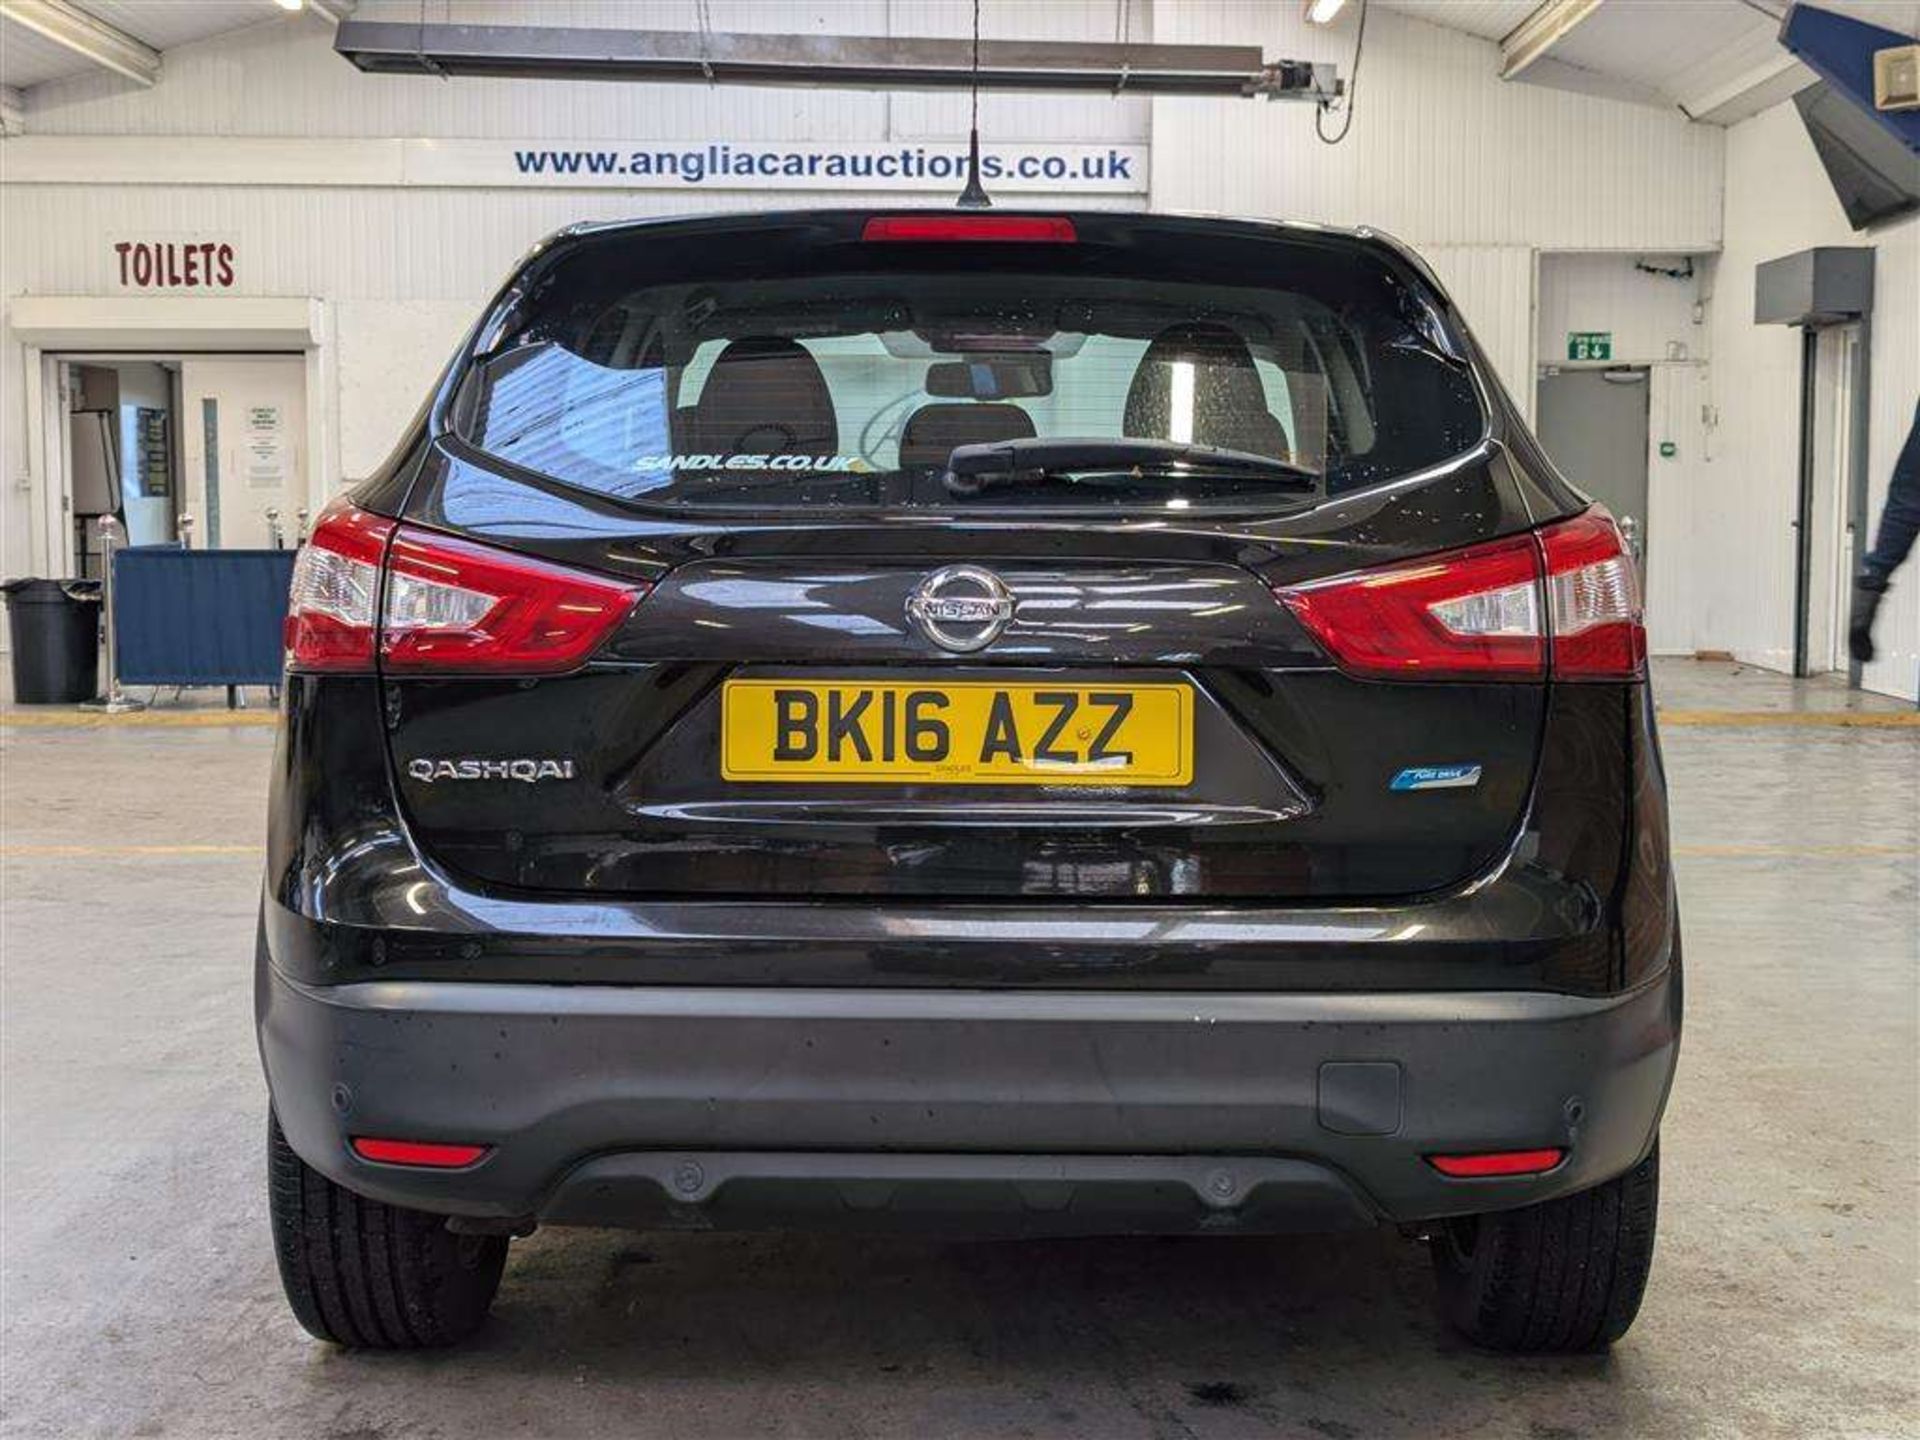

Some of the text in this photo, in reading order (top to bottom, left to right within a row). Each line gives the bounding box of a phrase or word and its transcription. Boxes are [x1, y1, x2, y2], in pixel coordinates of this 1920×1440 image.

[515, 146, 1131, 181] www.angliacarauctions.co.uk
[114, 242, 235, 288] TOILETS
[633, 454, 860, 471] SANDLES.CO.UK
[924, 601, 1001, 617] NISSAN
[773, 689, 1134, 765] BK16 AZZ
[408, 758, 573, 783] QASHQAI
